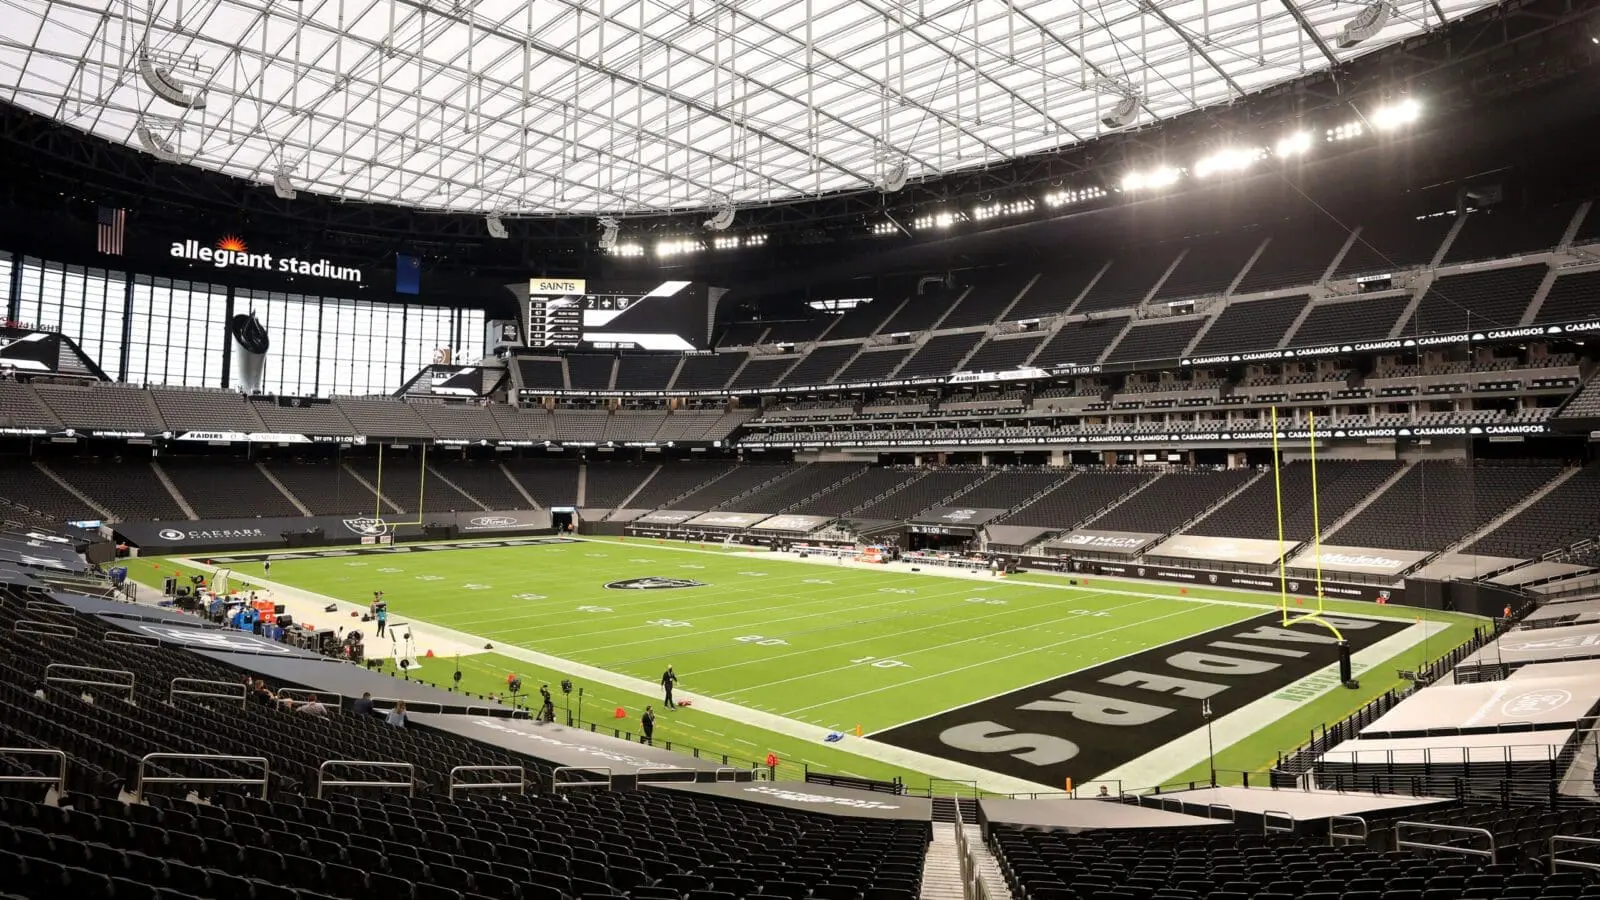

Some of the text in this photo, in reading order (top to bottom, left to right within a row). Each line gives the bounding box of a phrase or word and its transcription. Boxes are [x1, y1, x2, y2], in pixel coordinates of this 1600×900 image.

[170, 239, 362, 282] allegiant stadium
[540, 282, 575, 291] SAINTS
[588, 300, 595, 309] 2
[1191, 355, 1230, 366] CASAMIGOS
[1242, 351, 1282, 361] CASAMIGOS
[1296, 346, 1340, 357] CASAMIGOS
[1354, 340, 1402, 352] CASAMIGOS
[1418, 334, 1470, 346] CASAMIGOS
[1487, 327, 1544, 339] CASAMIGOS
[1181, 433, 1219, 441] CASAMIGOS
[1232, 432, 1273, 440] CASAMIGOS
[1347, 429, 1396, 437] CASAMIGOS
[1413, 427, 1466, 436] CASAMIGOS
[1485, 425, 1544, 434] CASAMIGOS
[188, 529, 262, 538] CAESARS
[1094, 536, 1146, 545] MGM
[733, 634, 785, 647] 20
[850, 656, 904, 668] 10
[937, 613, 1381, 768] RAIDERS
